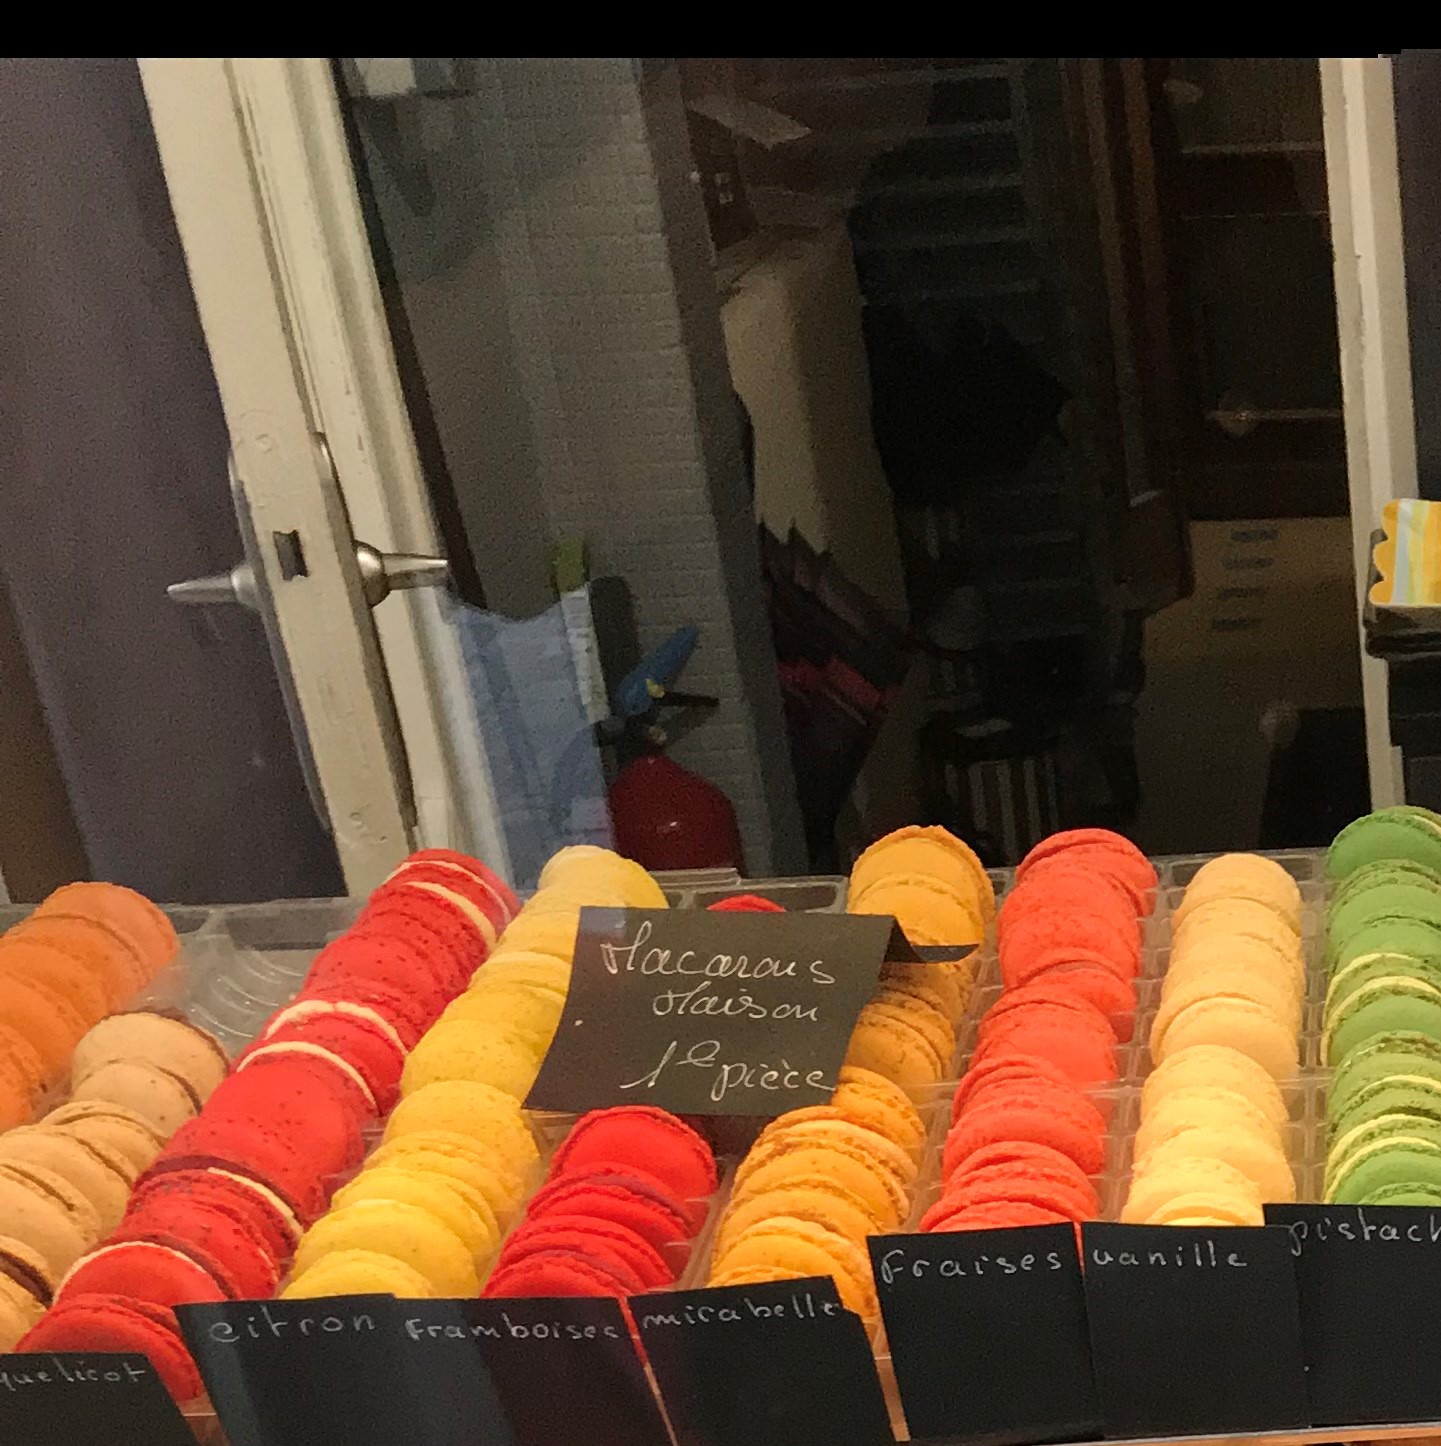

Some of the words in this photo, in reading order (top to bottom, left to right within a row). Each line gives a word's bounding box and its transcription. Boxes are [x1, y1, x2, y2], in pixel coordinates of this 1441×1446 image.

[602, 921, 837, 987] Macarons
[653, 983, 823, 1022] Maison
[712, 1058, 837, 1101] pièce
